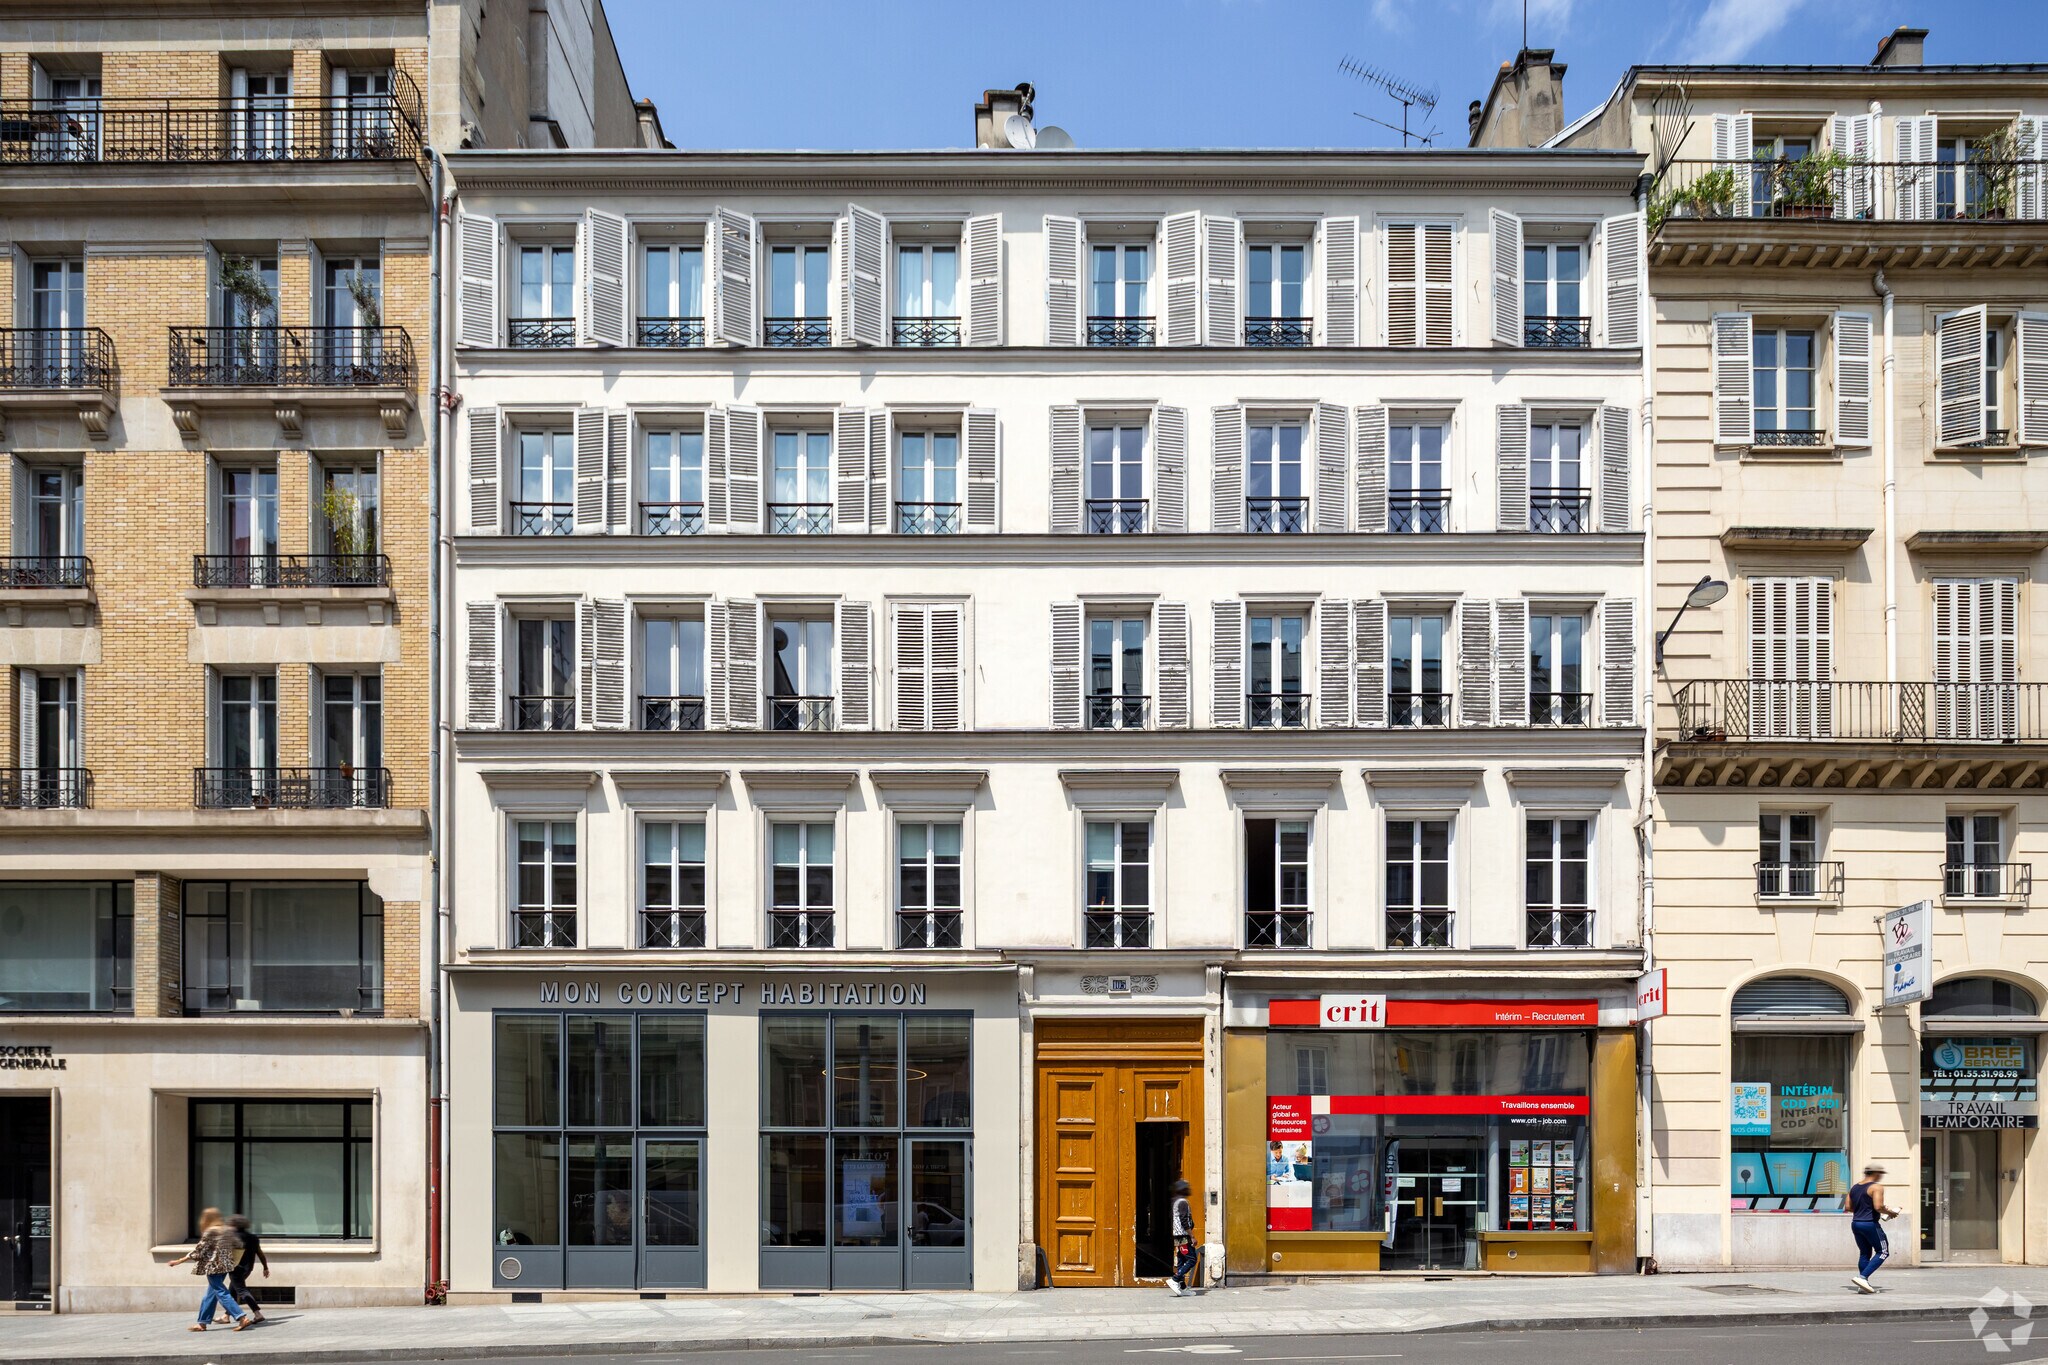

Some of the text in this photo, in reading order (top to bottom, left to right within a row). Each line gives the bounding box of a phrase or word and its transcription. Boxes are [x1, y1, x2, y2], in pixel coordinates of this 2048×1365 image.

[1887, 950, 1922, 965] TEMPORAIRE
[1894, 946, 1914, 957] TRAVAIL
[540, 981, 927, 1005] MON CONCEPT HABITATION
[1638, 986, 1661, 1006] crit
[1326, 999, 1381, 1023] crit
[1495, 1012, 1522, 1021] Intérim
[1532, 1012, 1585, 1021] Recrutement
[1964, 1047, 2022, 1059] BREF
[1964, 1059, 2022, 1067] SERVICE
[1953, 1070, 2018, 1078] 01.55.31.98.98
[1781, 1082, 1833, 1096] INTÉRIM
[1500, 1101, 1575, 1110] Travaillons ensemble
[1781, 1098, 1807, 1109] CDD
[1817, 1098, 1840, 1109] CDI
[1947, 1102, 2007, 1115] TRAVAIL
[1272, 1111, 1290, 1119] global
[1927, 1115, 2024, 1129] TEMPORAIRE
